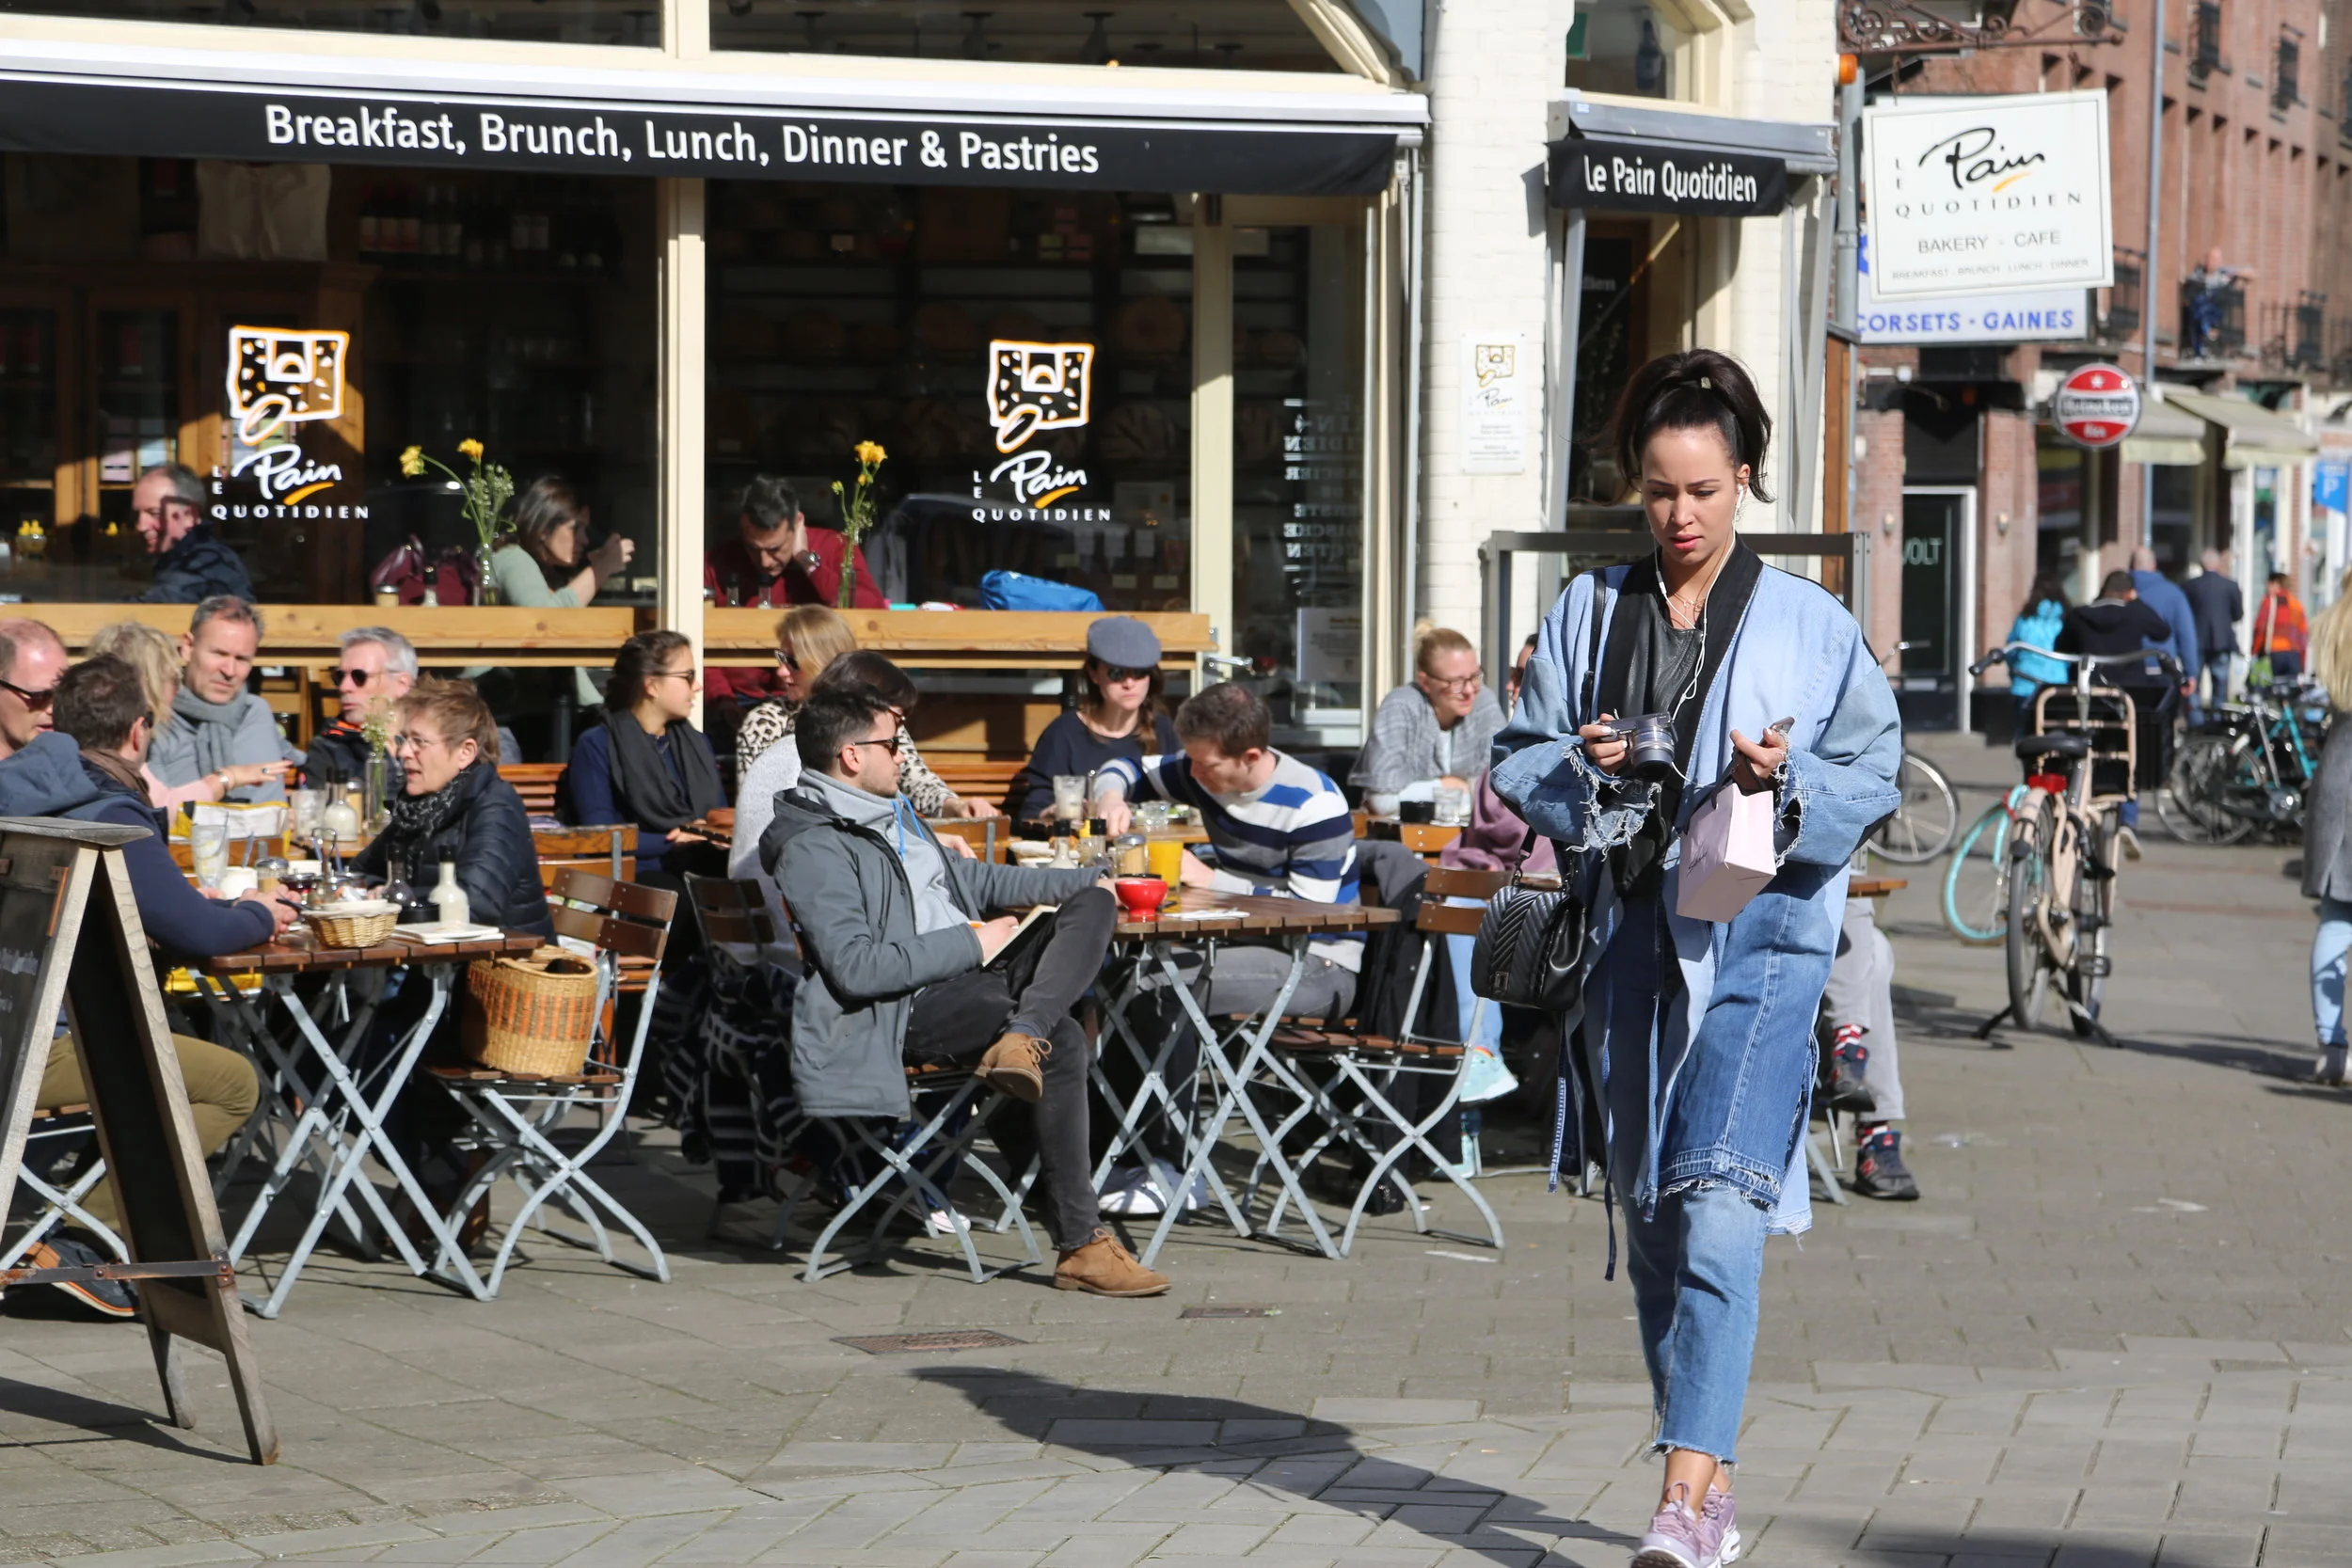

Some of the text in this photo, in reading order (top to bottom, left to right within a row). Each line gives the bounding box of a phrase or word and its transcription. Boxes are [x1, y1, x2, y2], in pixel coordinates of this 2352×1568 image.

[265, 104, 1100, 174] Breakfast, Brunch, Lunch, Dinner & Pastries
[1917, 126, 2045, 190] Pain
[1583, 154, 1757, 202] Le Pain Quotidien
[1895, 191, 2082, 219] QUOTIDIEN
[1917, 230, 2062, 254] BAKERY CAFE
[1958, 264, 2000, 277] BRUNCH
[2008, 261, 2042, 273] LUNCH
[2050, 258, 2089, 270] DINNER
[1982, 309, 2074, 330] GAINES
[230, 443, 342, 500] Pain
[989, 450, 1088, 504] Pain
[211, 503, 369, 520] QUOTIDIEN
[972, 507, 1111, 523] QUOTIDIEN
